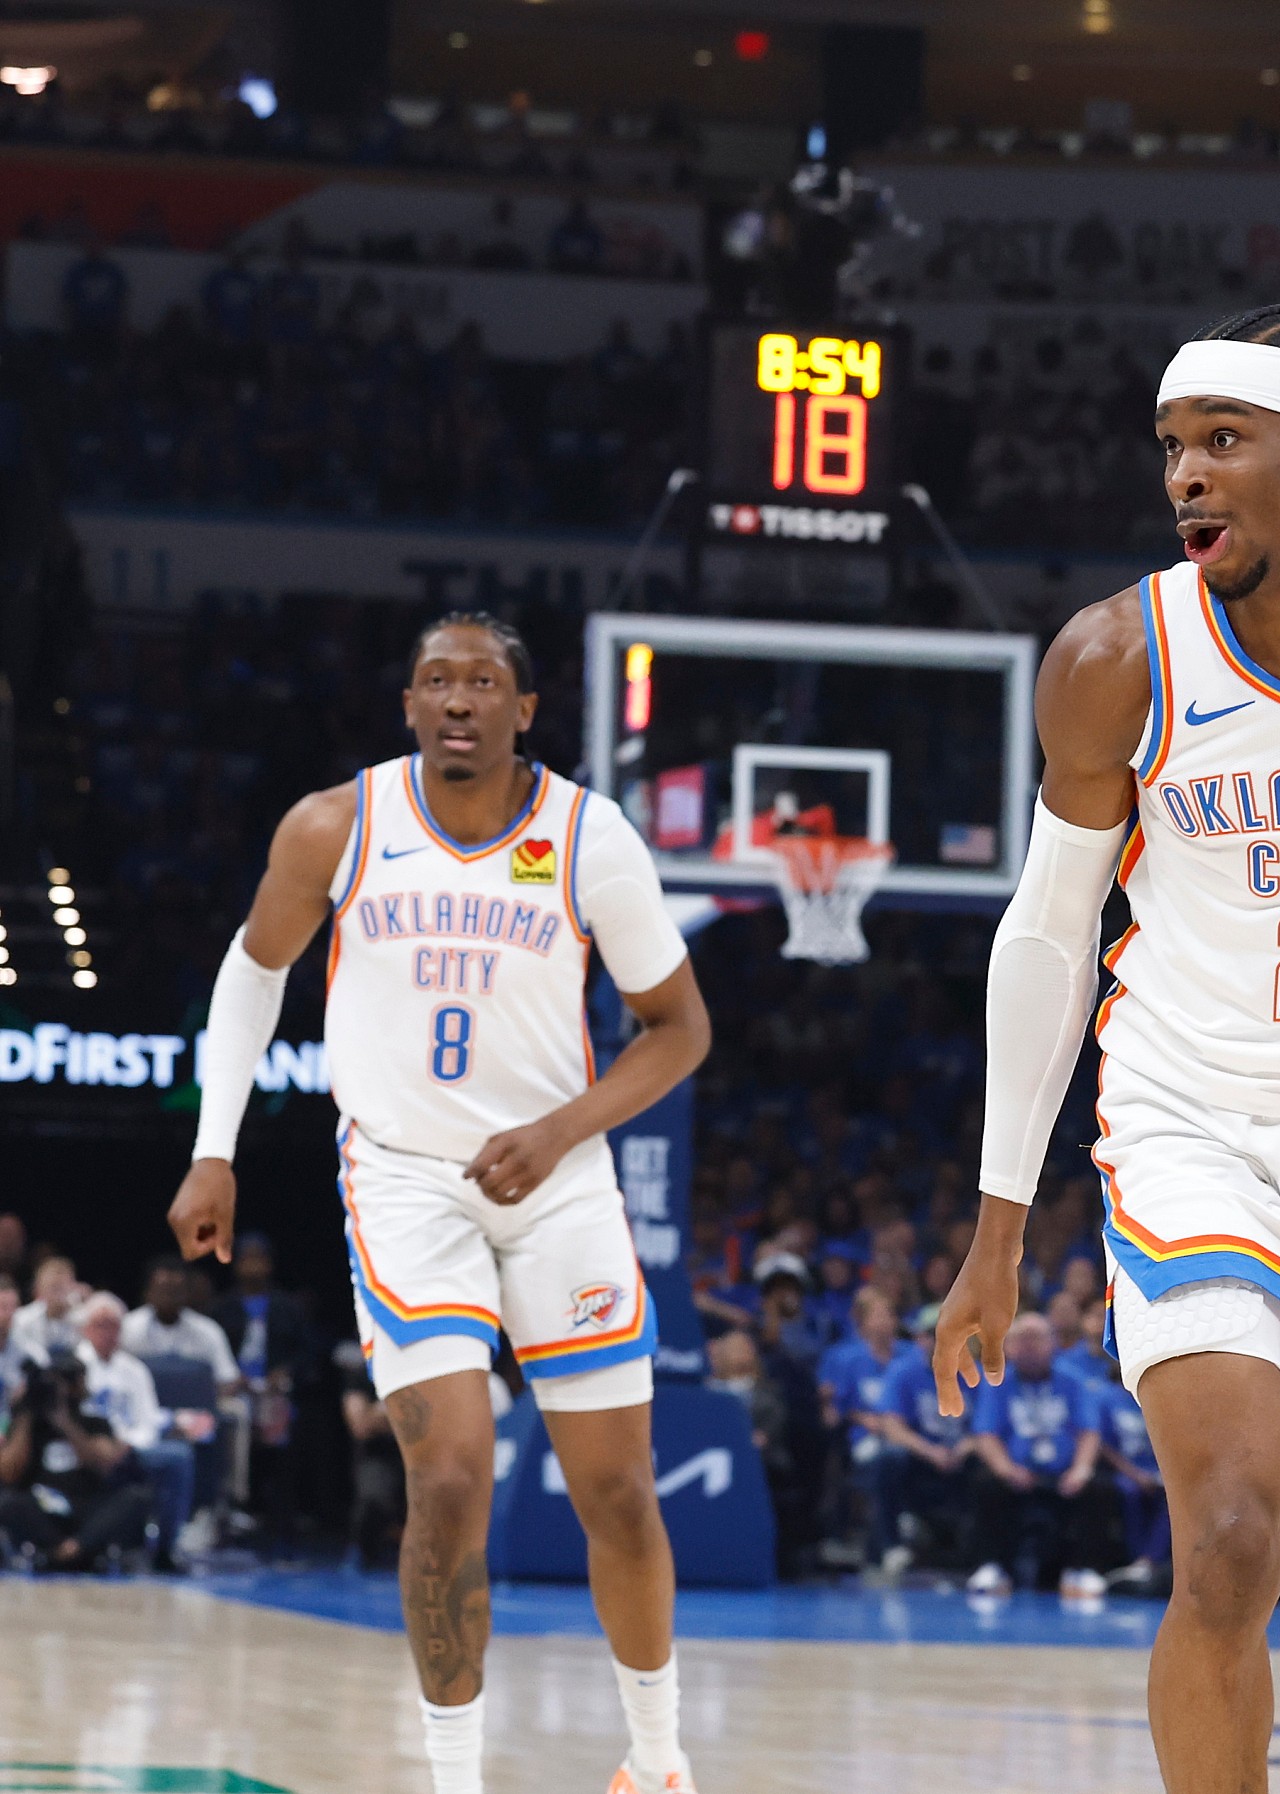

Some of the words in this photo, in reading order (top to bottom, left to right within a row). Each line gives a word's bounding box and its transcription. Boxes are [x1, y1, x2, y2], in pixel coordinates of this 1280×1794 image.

[757, 333, 882, 399] 8:54
[772, 392, 868, 496] 18
[357, 891, 563, 958] OKLAHOMA
[412, 944, 500, 996] CITY
[427, 1000, 477, 1087] 8
